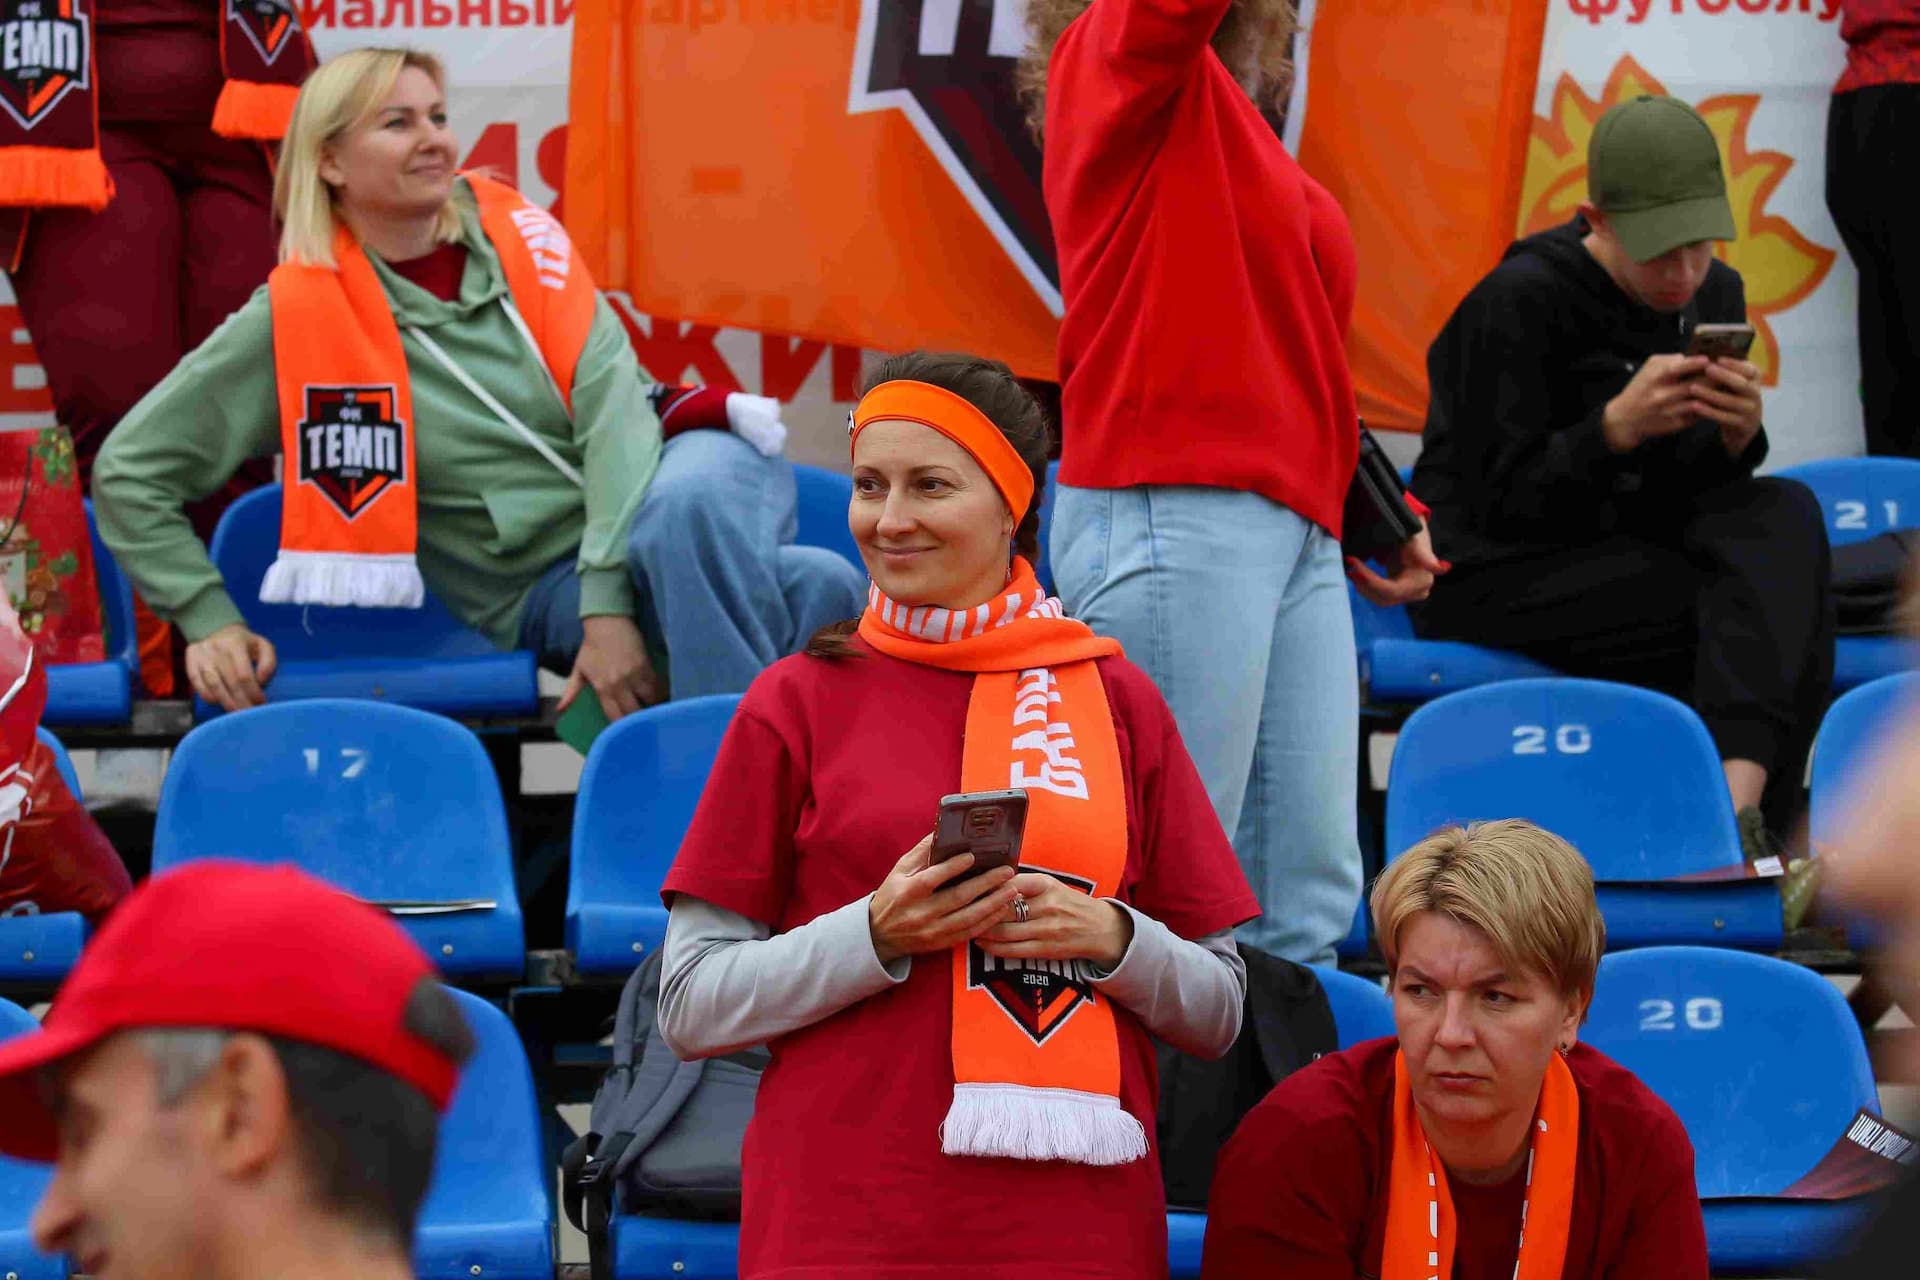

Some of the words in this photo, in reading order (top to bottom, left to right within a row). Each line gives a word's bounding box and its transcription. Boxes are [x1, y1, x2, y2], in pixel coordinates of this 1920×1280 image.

[0, 20, 77, 71] ЕМП
[305, 423, 397, 472] ТЕМП
[1836, 501, 1897, 529] 21
[1512, 724, 1590, 754] 20
[303, 748, 367, 778] 17
[1022, 973, 1050, 987] 2020
[1639, 997, 1723, 1031] 20
